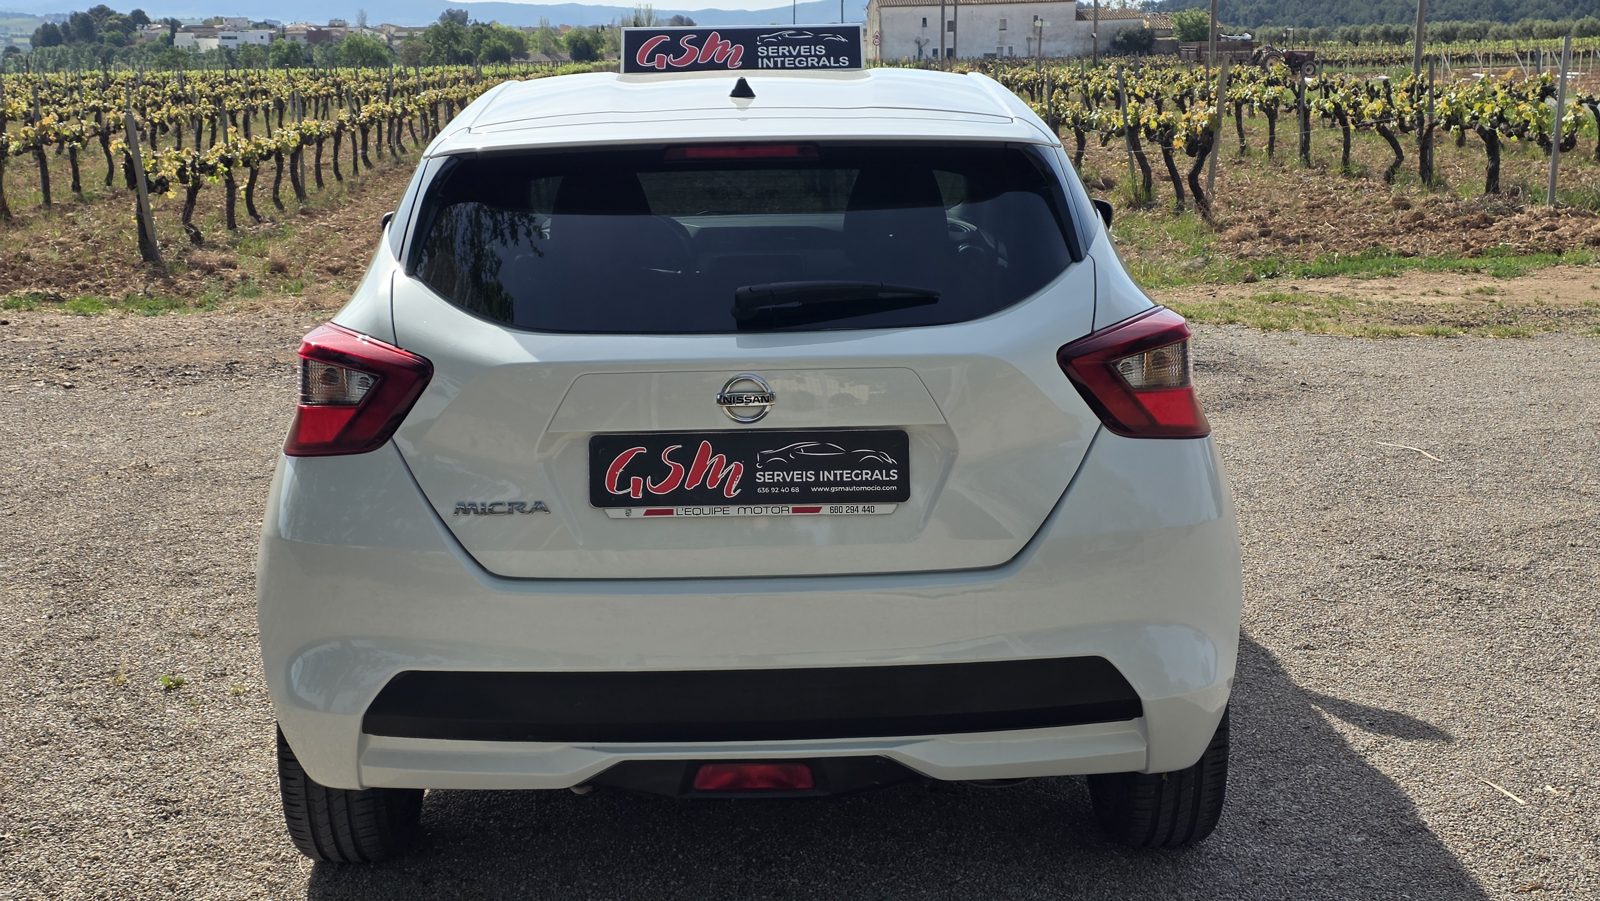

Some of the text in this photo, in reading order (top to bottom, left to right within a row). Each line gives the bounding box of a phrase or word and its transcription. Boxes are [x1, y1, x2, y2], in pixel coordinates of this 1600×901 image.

[757, 45, 826, 56] SERVEIS
[758, 56, 849, 68] INTEGRALS
[723, 396, 770, 404] NISSAN
[755, 469, 898, 483] SERVEIS INTEGRALS
[811, 484, 897, 493] www.gsmautomocio.com
[453, 500, 552, 516] MICRA
[676, 505, 790, 516] L'EQUIPE MOTOR
[845, 505, 859, 514] 294
[861, 505, 875, 513] 440
